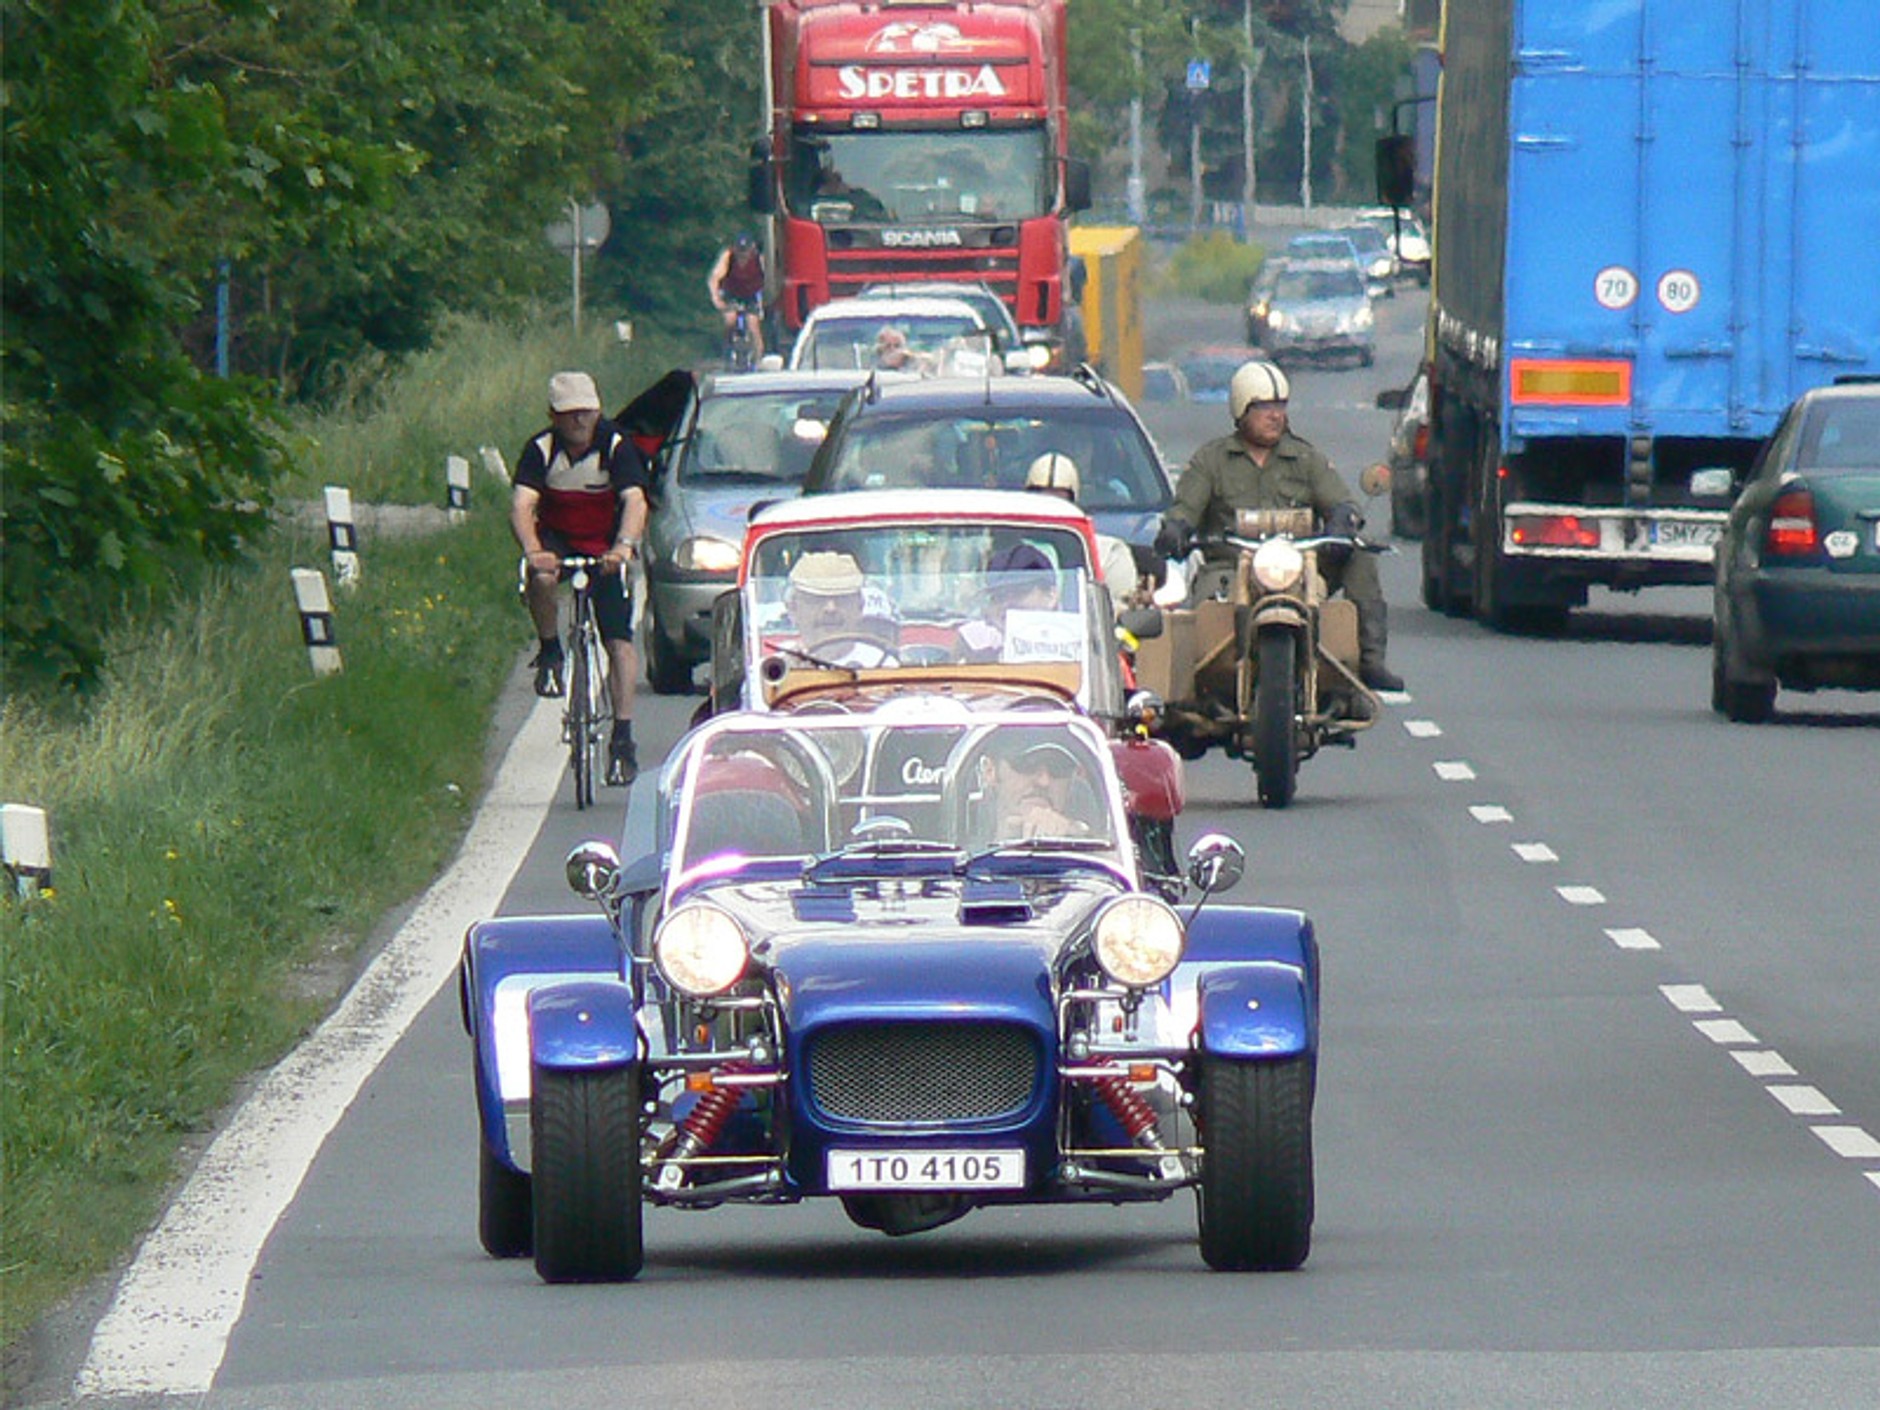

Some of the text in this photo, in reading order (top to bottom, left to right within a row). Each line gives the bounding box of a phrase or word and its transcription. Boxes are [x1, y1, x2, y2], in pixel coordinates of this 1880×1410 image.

[838, 64, 1007, 99] SPETRA
[881, 230, 962, 247] SCANIA
[1602, 279, 1628, 298] 70
[1667, 282, 1692, 301] 80
[921, 1156, 1001, 1181] 4105
